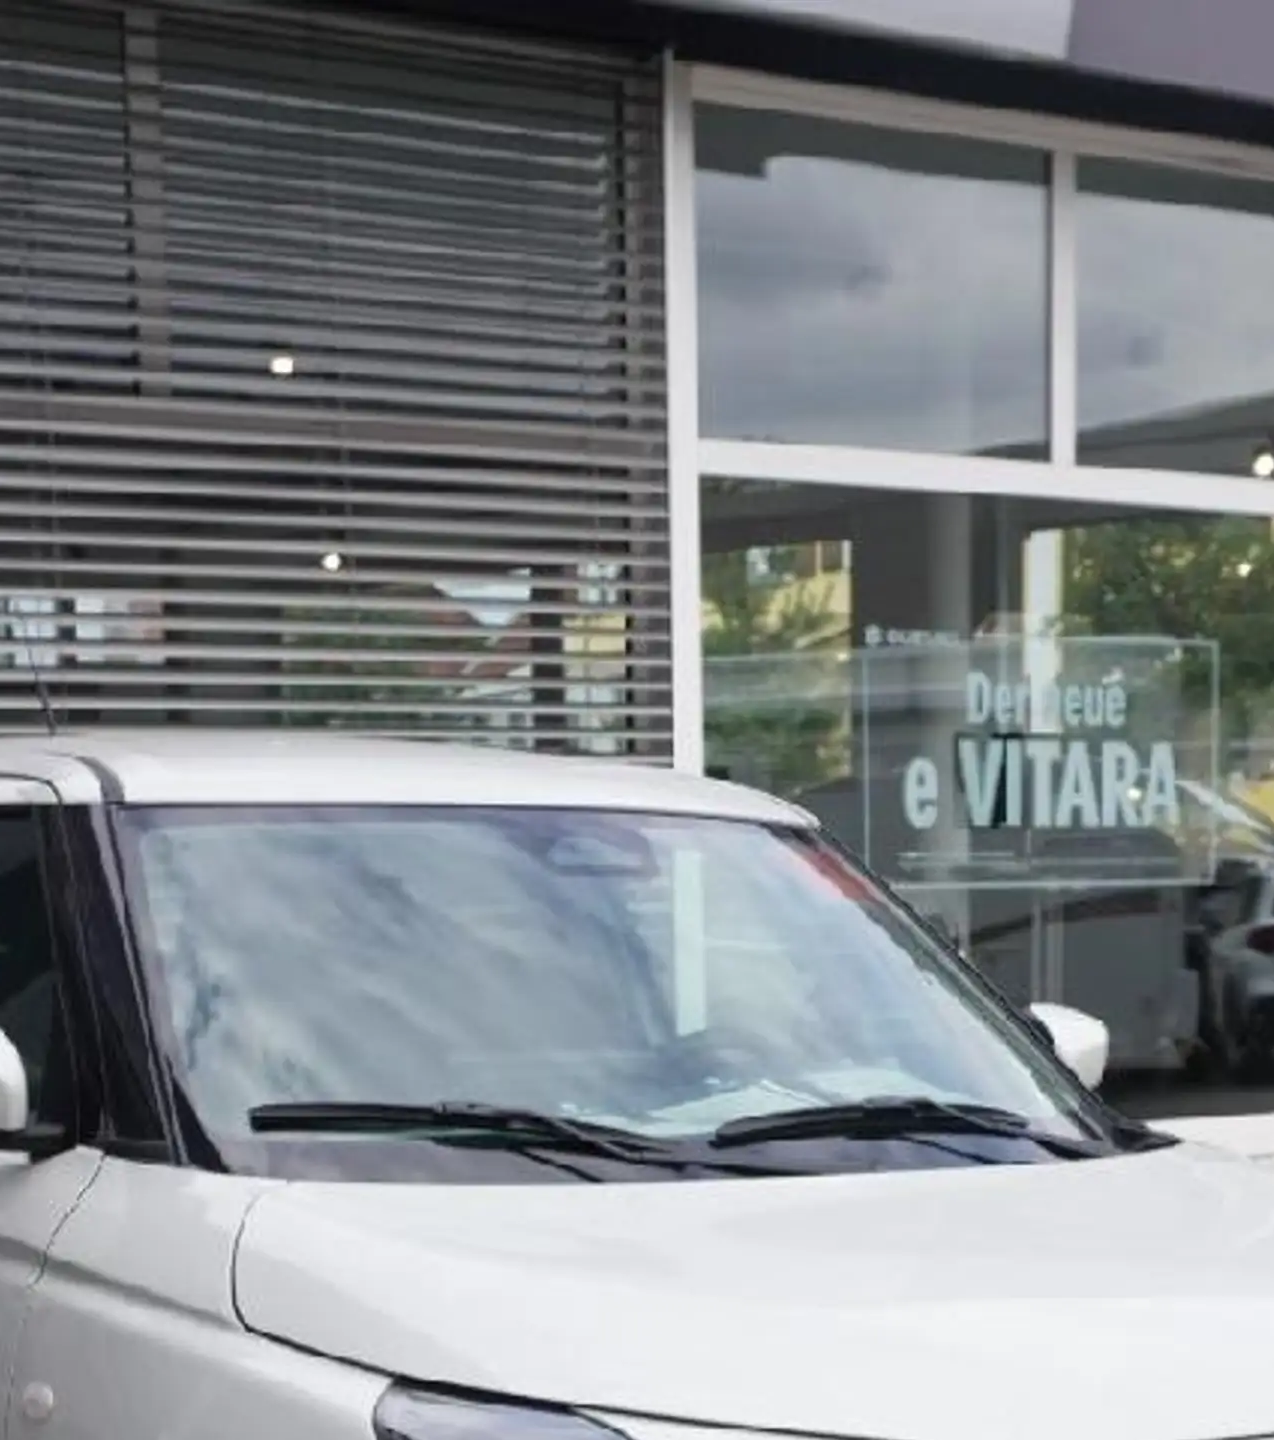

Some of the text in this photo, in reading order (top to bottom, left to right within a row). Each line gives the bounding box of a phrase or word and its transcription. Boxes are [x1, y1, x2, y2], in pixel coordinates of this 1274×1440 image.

[966, 672, 1127, 727] Der eue
[903, 738, 1181, 830] e VITARA
